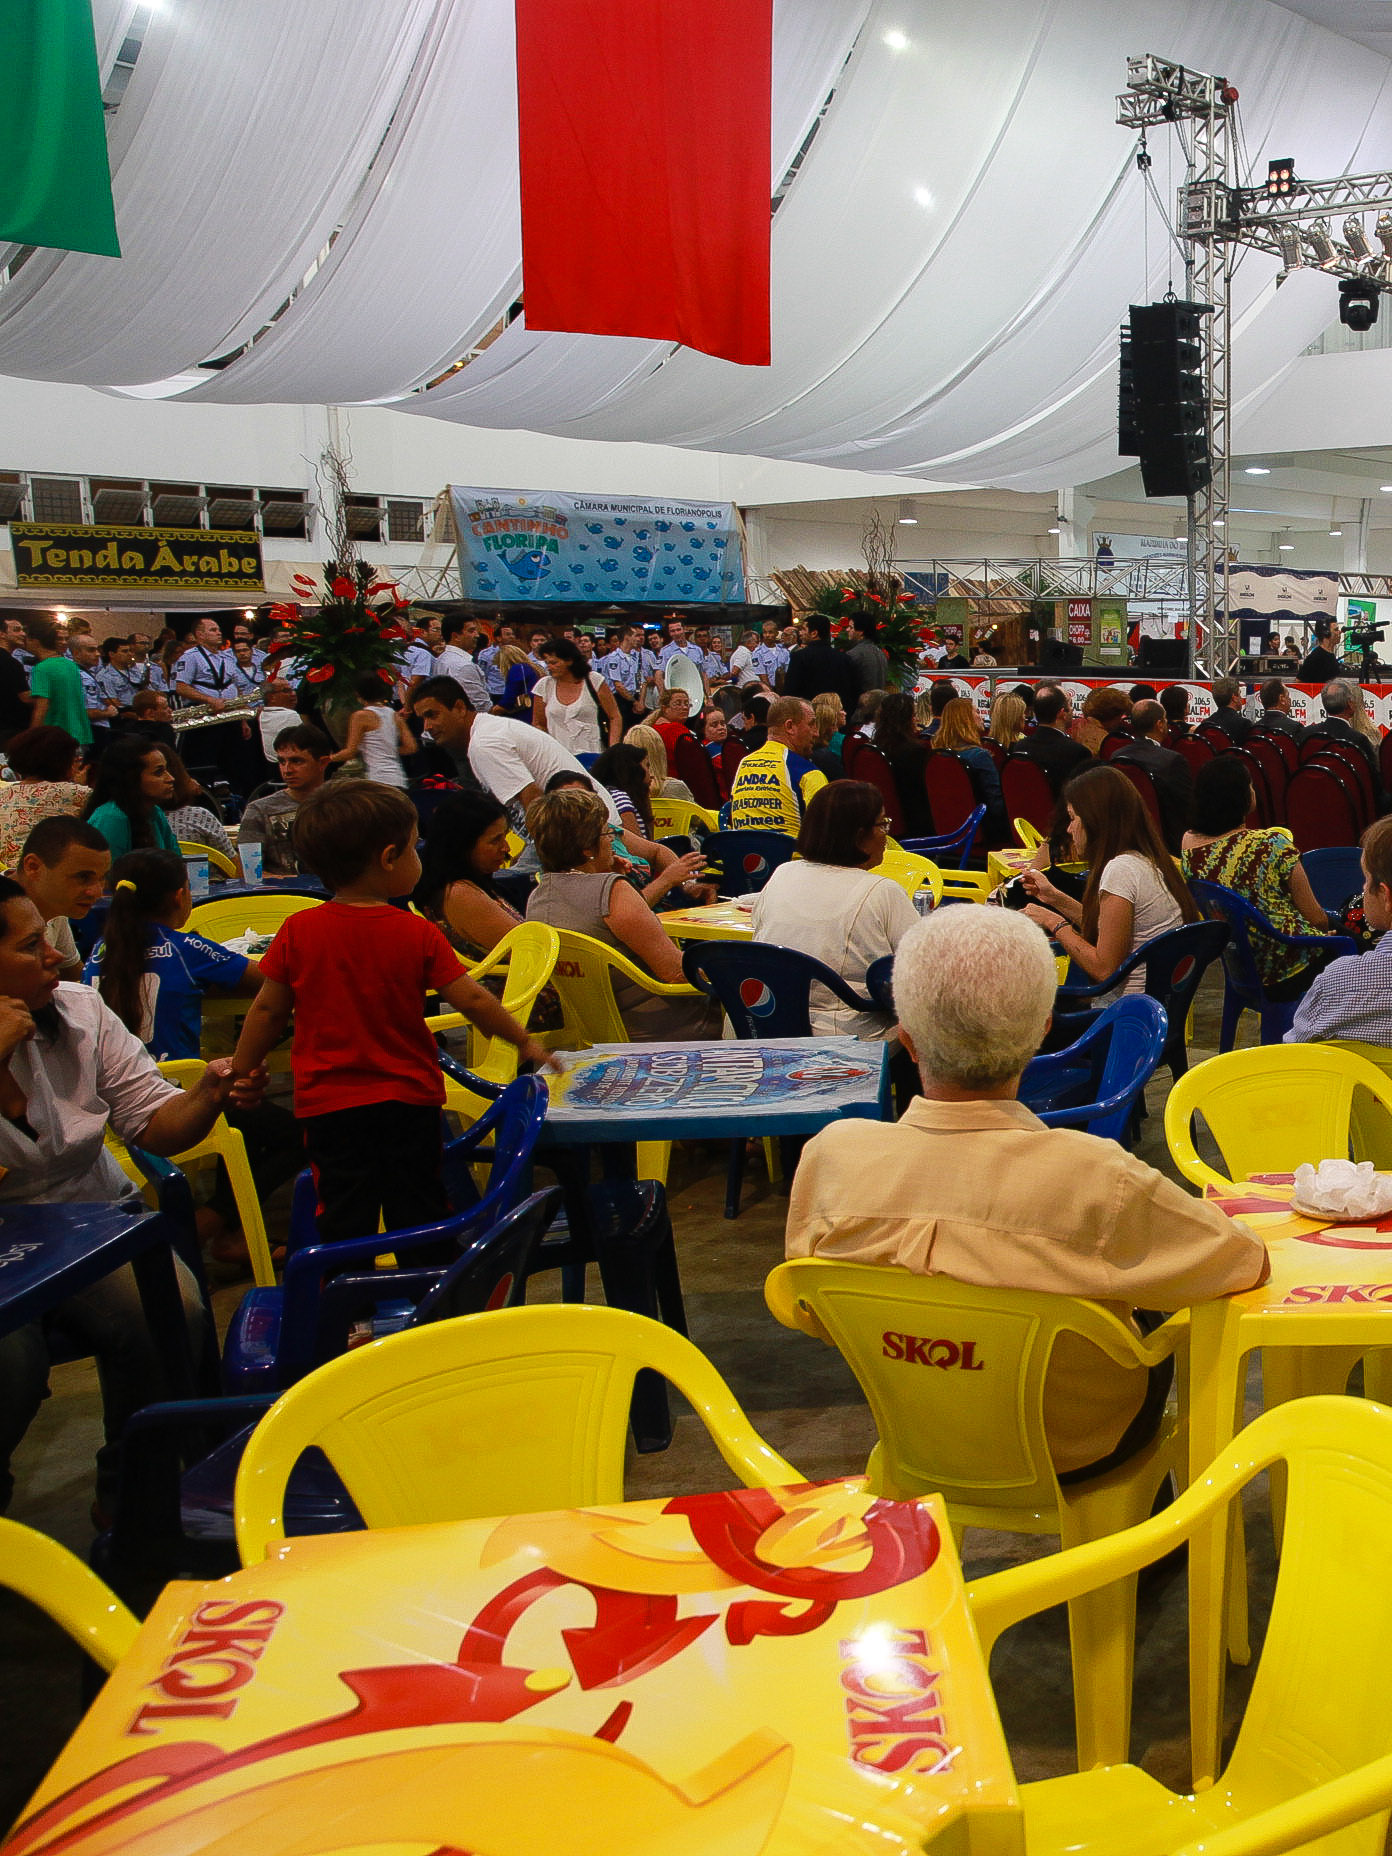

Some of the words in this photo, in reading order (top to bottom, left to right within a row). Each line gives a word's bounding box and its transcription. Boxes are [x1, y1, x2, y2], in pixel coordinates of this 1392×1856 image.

[574, 500, 609, 513] CÂMARA
[610, 503, 653, 514] MUNICIPAL
[655, 505, 666, 514] DE
[666, 505, 723, 519] FLORIANÓPOLIS
[471, 518, 570, 540] CANTINHO
[18, 540, 145, 570] Tenda
[150, 539, 258, 574] Árabe
[1068, 603, 1091, 617] CAIXA
[673, 1050, 766, 1108] ANTARCTICA
[882, 1330, 985, 1372] SKOL
[126, 1599, 286, 1736] SKOL
[838, 1628, 953, 1774] SKOL
